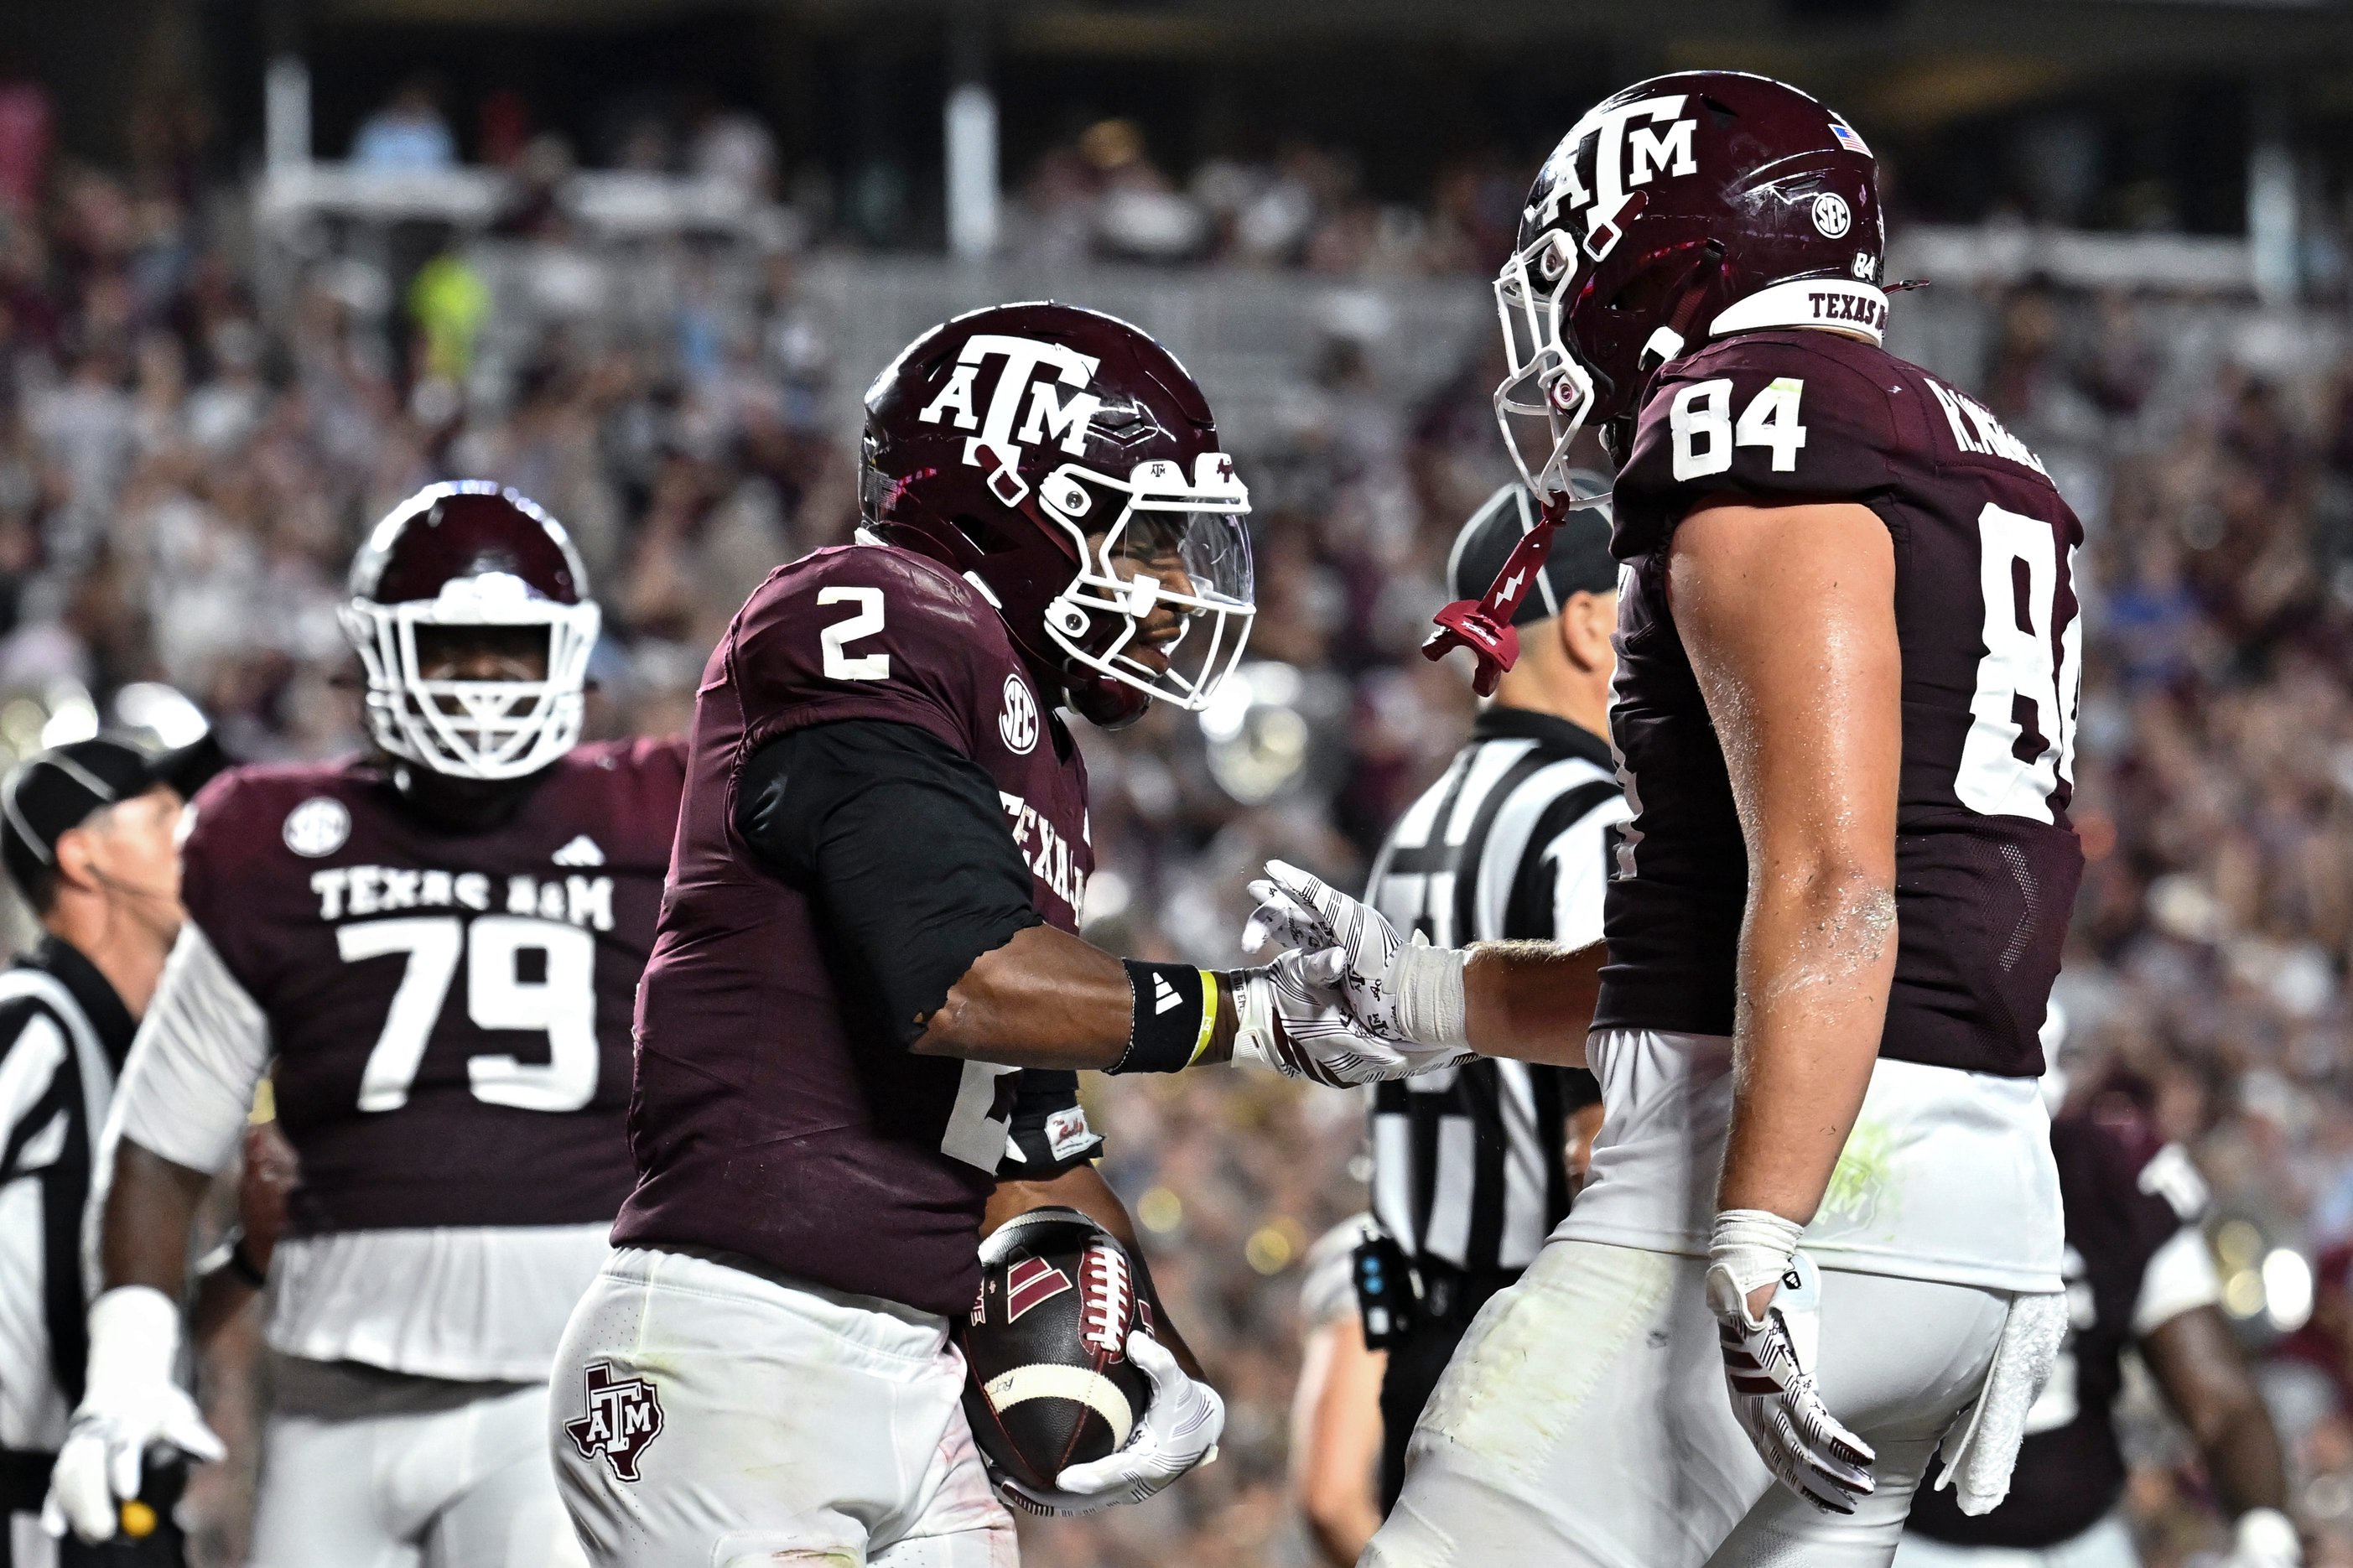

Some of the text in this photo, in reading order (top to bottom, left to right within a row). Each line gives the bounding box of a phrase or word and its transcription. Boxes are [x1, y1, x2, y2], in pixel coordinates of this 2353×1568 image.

[1815, 196, 1847, 234] SEC
[1853, 252, 1876, 281] 84
[1809, 293, 1876, 325] TEXAS
[1670, 377, 1807, 482] 84
[817, 586, 890, 681] 2
[1001, 680, 1035, 748] SEC
[310, 865, 615, 931] TEXAS A&M
[336, 916, 600, 1112] 79
